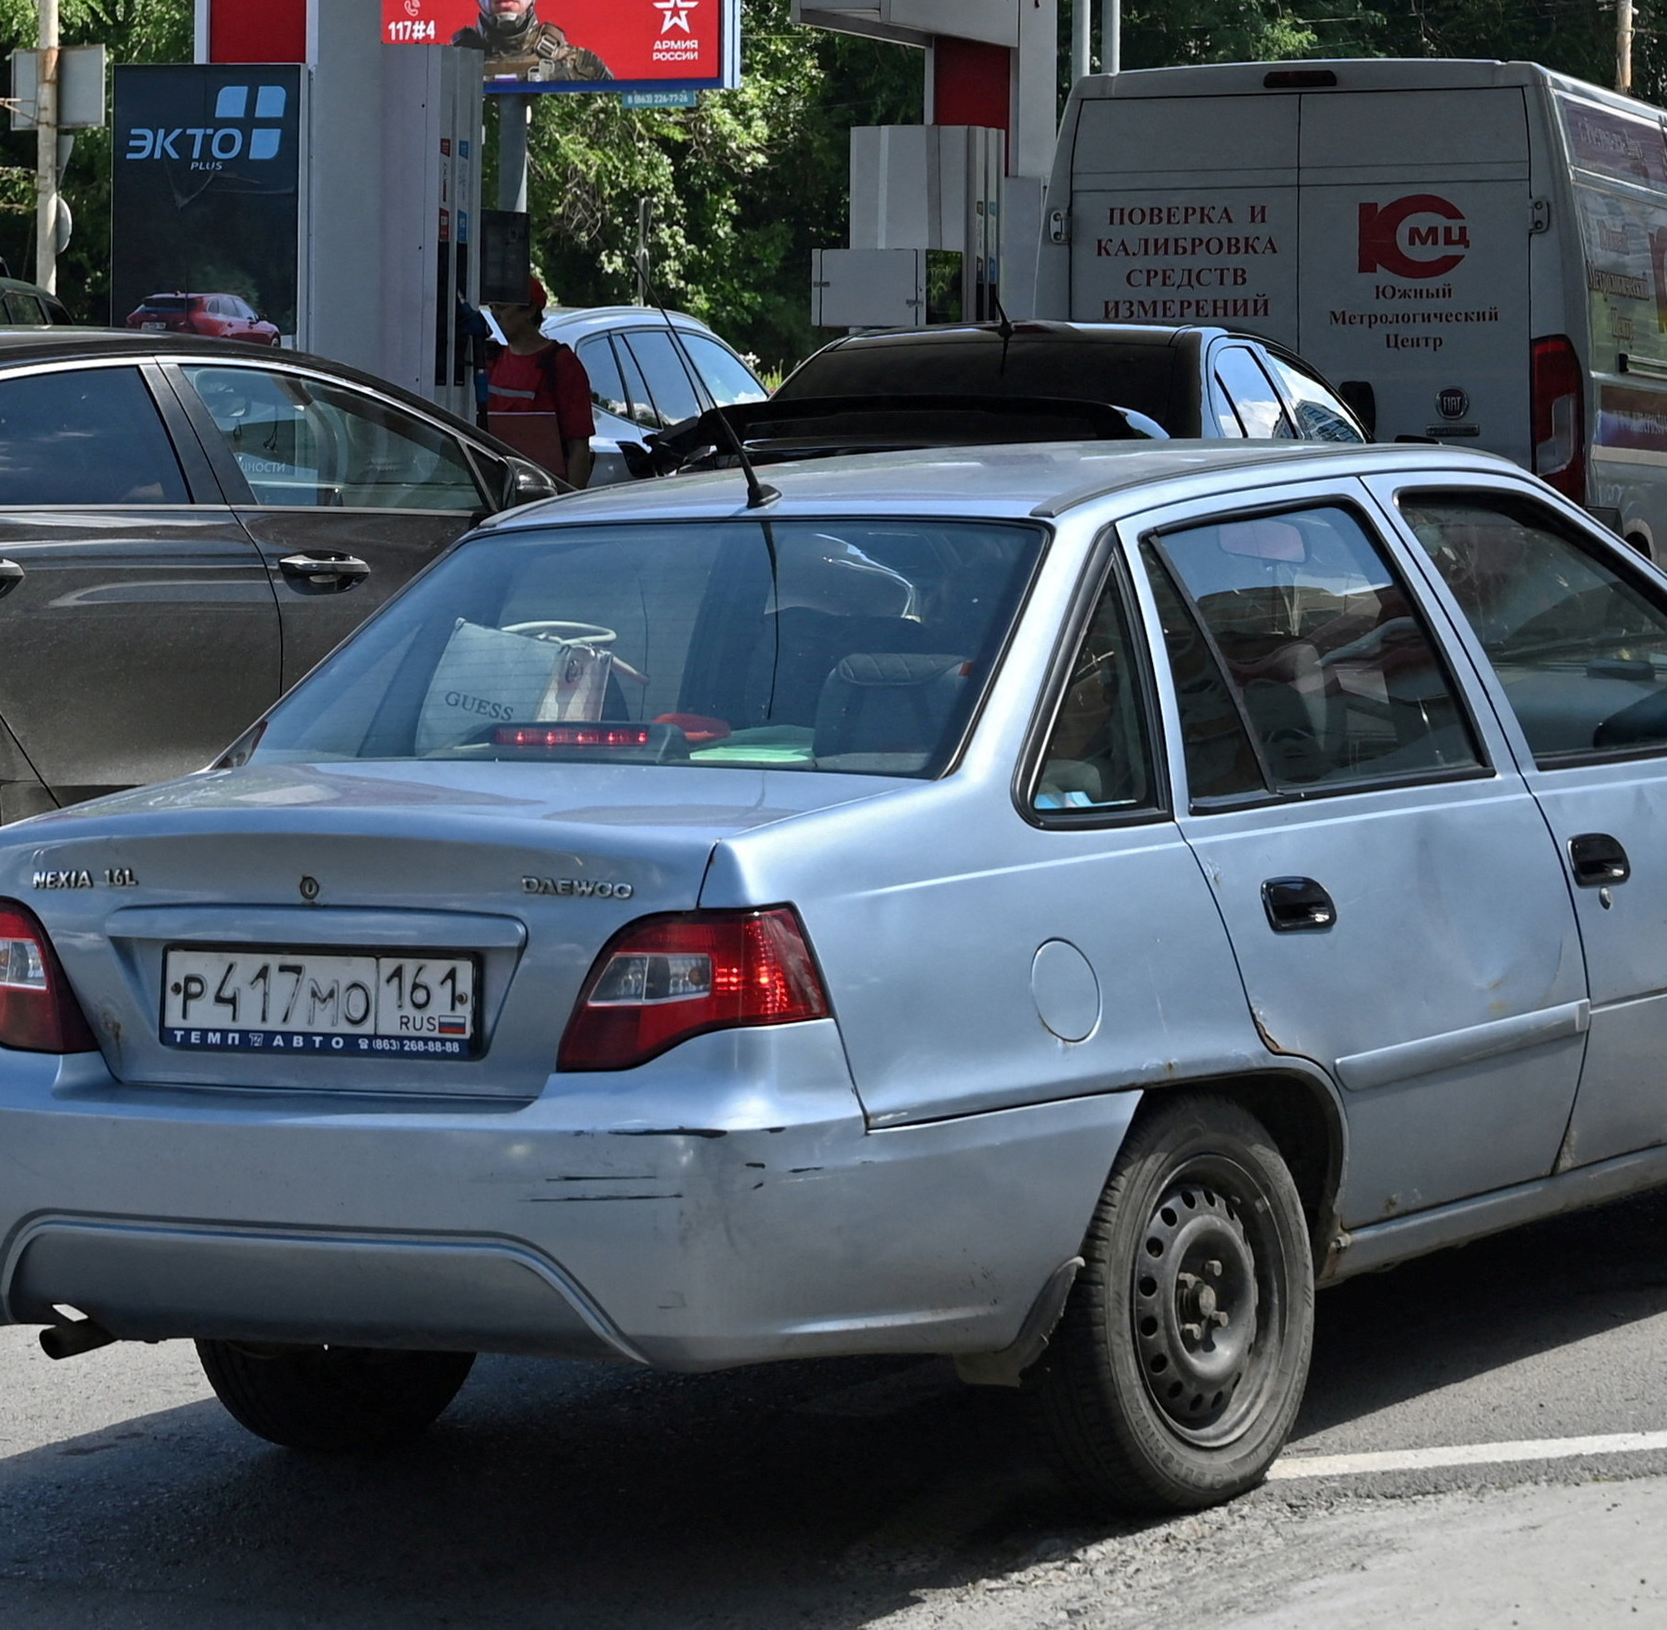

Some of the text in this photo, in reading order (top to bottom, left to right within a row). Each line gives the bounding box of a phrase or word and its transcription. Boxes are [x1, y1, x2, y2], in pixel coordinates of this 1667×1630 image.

[387, 19, 436, 41] 117#4
[652, 50, 699, 62] РОССИИ
[653, 39, 699, 51] АРМИЯ
[125, 127, 244, 161] ЭКТО
[190, 160, 224, 171] PLUS
[1108, 204, 1268, 226] ПОВЕРКА И
[1095, 235, 1279, 257] КАЛИБРОВКА
[1125, 266, 1248, 290] СРЕДСТВ
[1374, 282, 1453, 300] Южный
[1102, 293, 1271, 321] ИЗМЕРЕНИЙ
[1329, 306, 1500, 329] Метрологический
[1385, 333, 1444, 352] Центр
[1442, 395, 1463, 412] FIAT
[444, 690, 515, 722] GUESS
[31, 869, 94, 889] NEXIA
[521, 875, 634, 900] DAEWOO
[182, 962, 457, 1027] Р417МО 161
[398, 1015, 437, 1032] RUS
[173, 1030, 241, 1046] ТЕМП
[272, 1035, 346, 1050] АВТО
[371, 1039, 401, 1052] (863)
[402, 1039, 460, 1054] 268-88-88
